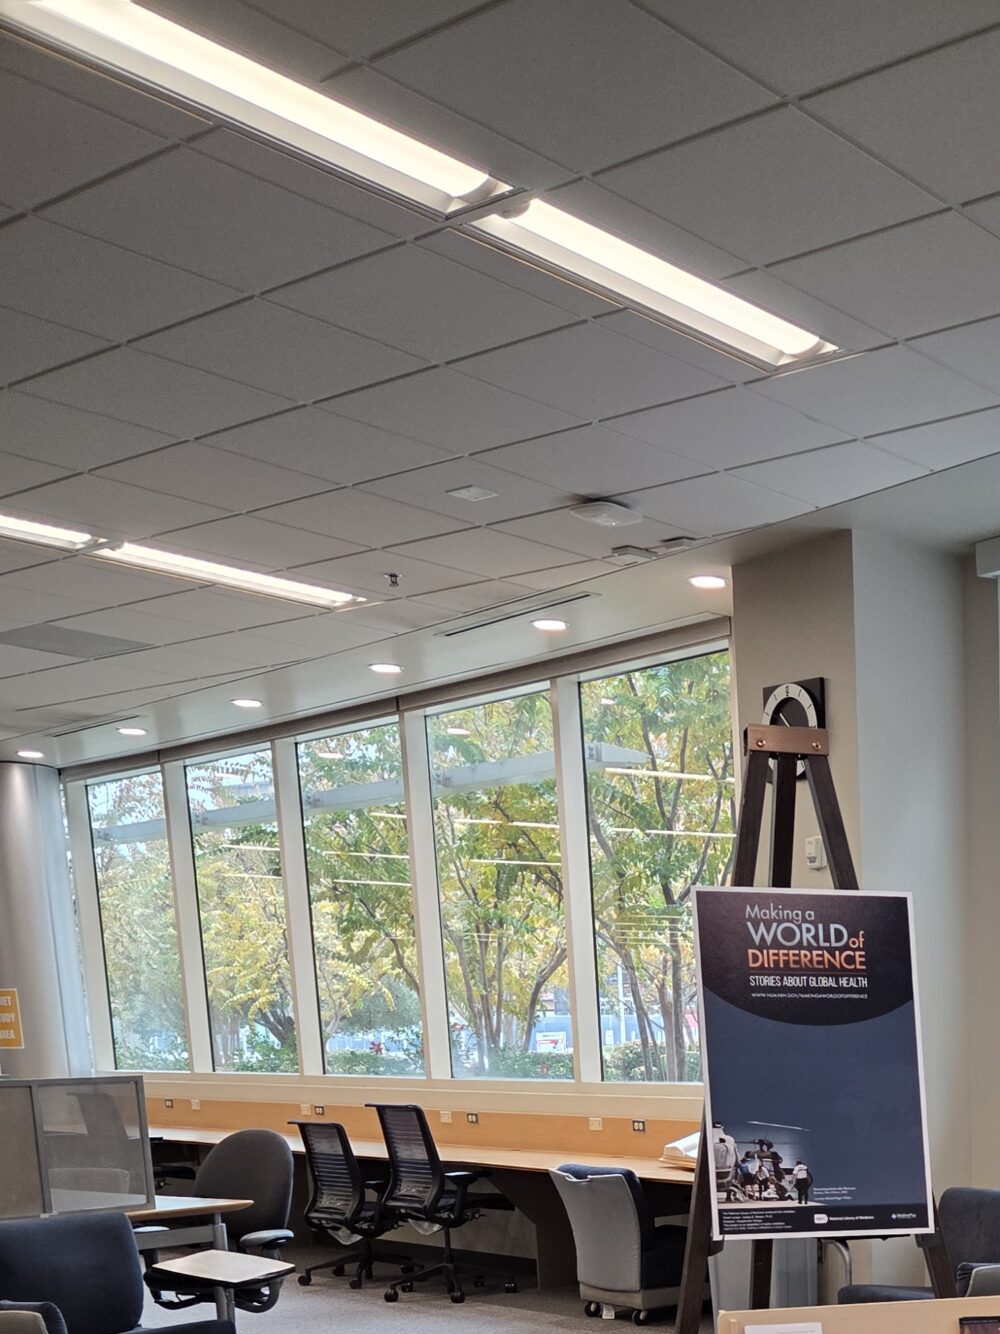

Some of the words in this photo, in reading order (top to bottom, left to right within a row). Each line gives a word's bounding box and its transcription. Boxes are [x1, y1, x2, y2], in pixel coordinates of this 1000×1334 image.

[745, 903, 801, 924] Making
[805, 910, 814, 920] a
[747, 922, 848, 946] WORLD
[849, 931, 864, 948] of
[748, 949, 866, 969] DIFFERENCE
[750, 976, 781, 986] STORIES
[783, 976, 807, 986] ABOUT
[809, 977, 838, 987] GLOBAL
[839, 977, 867, 987] HEALTH
